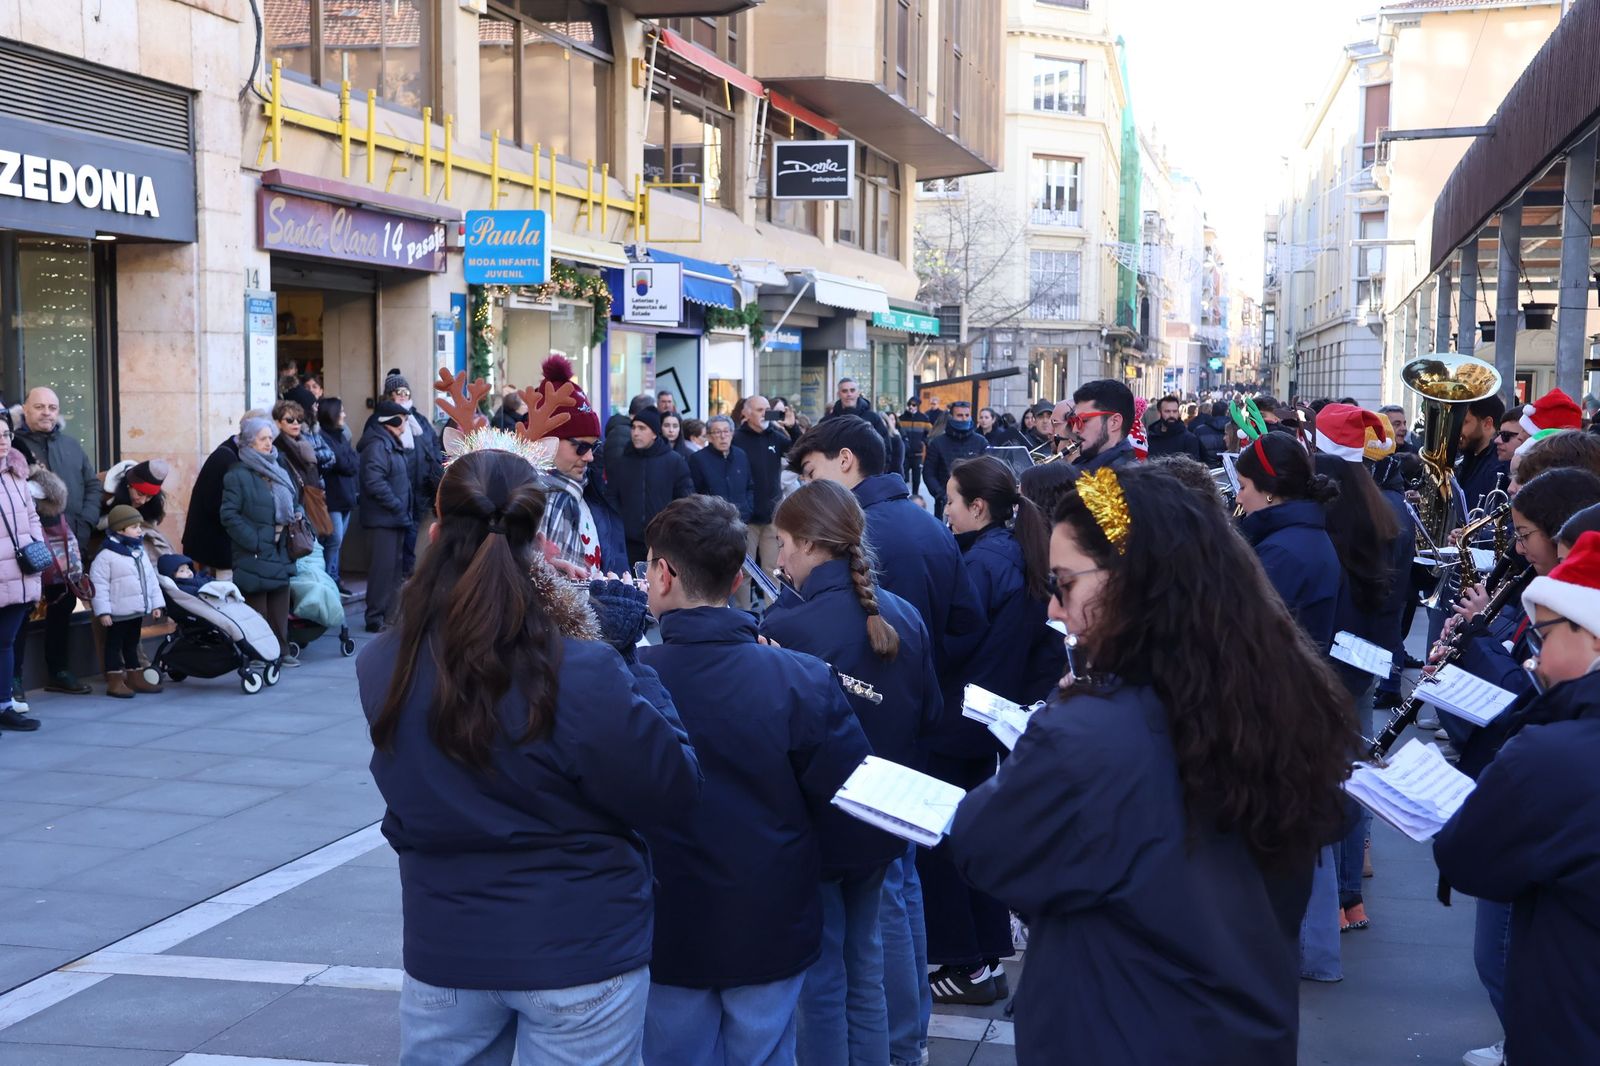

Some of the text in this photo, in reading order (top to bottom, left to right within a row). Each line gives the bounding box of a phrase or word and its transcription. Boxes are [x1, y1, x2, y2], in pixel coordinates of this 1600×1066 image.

[778, 159, 847, 176] Dania
[0, 150, 160, 218] ZEDONIA
[267, 197, 446, 265] Santa Clara 14 Pasaje
[469, 216, 541, 246] Paula
[468, 257, 541, 267] MODA INFANTIL
[246, 268, 260, 289] 14
[484, 269, 525, 279] JUVENIL
